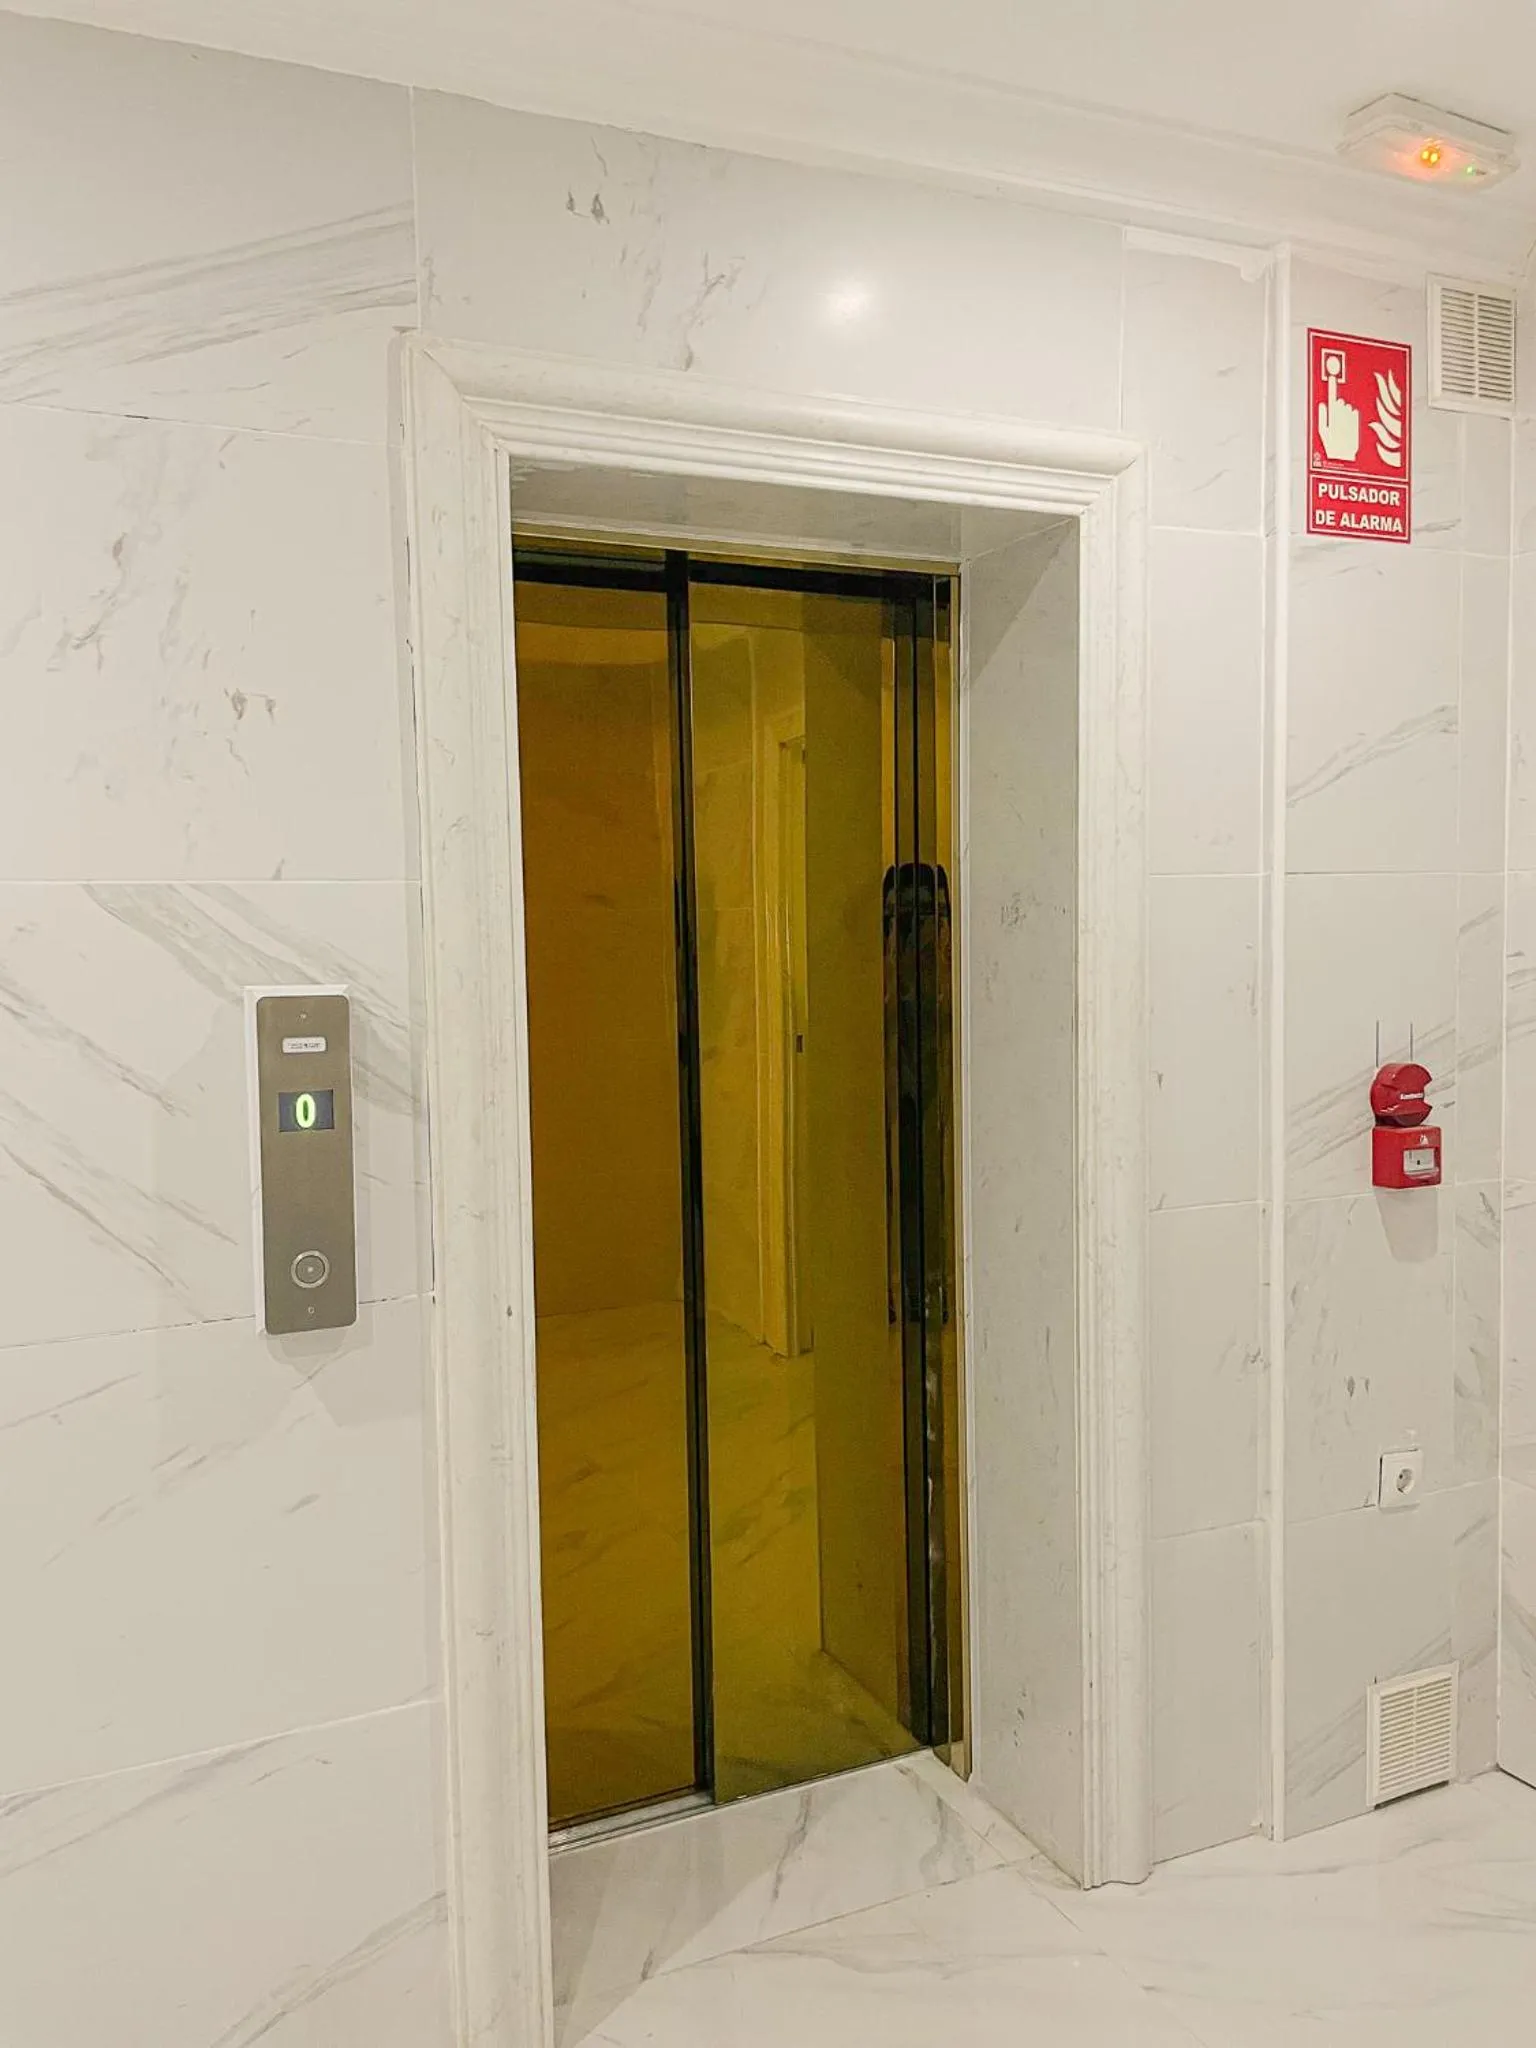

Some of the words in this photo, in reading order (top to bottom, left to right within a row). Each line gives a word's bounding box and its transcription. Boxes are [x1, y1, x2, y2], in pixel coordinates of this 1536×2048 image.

[1318, 483, 1400, 506] PULSADOR
[1315, 509, 1336, 526] DE
[1340, 512, 1403, 533] ALARMA
[295, 1093, 316, 1128] 0
